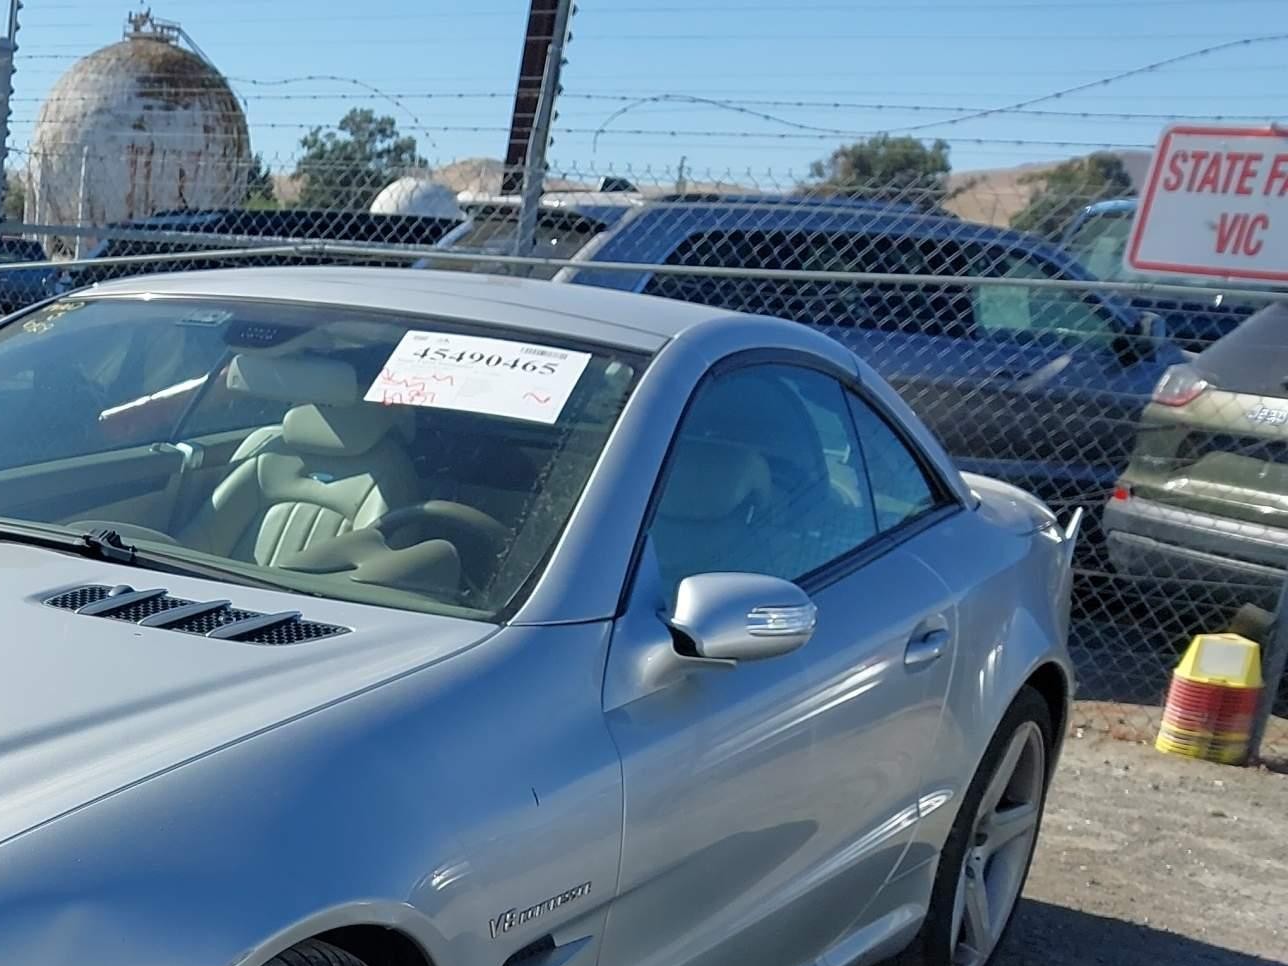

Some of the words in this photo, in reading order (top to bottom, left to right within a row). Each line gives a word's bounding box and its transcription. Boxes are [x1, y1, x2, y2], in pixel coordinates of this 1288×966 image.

[1163, 149, 1264, 195] STATE
[1263, 153, 1288, 197] F
[1215, 212, 1269, 256] VIC
[413, 346, 560, 376] 45490465
